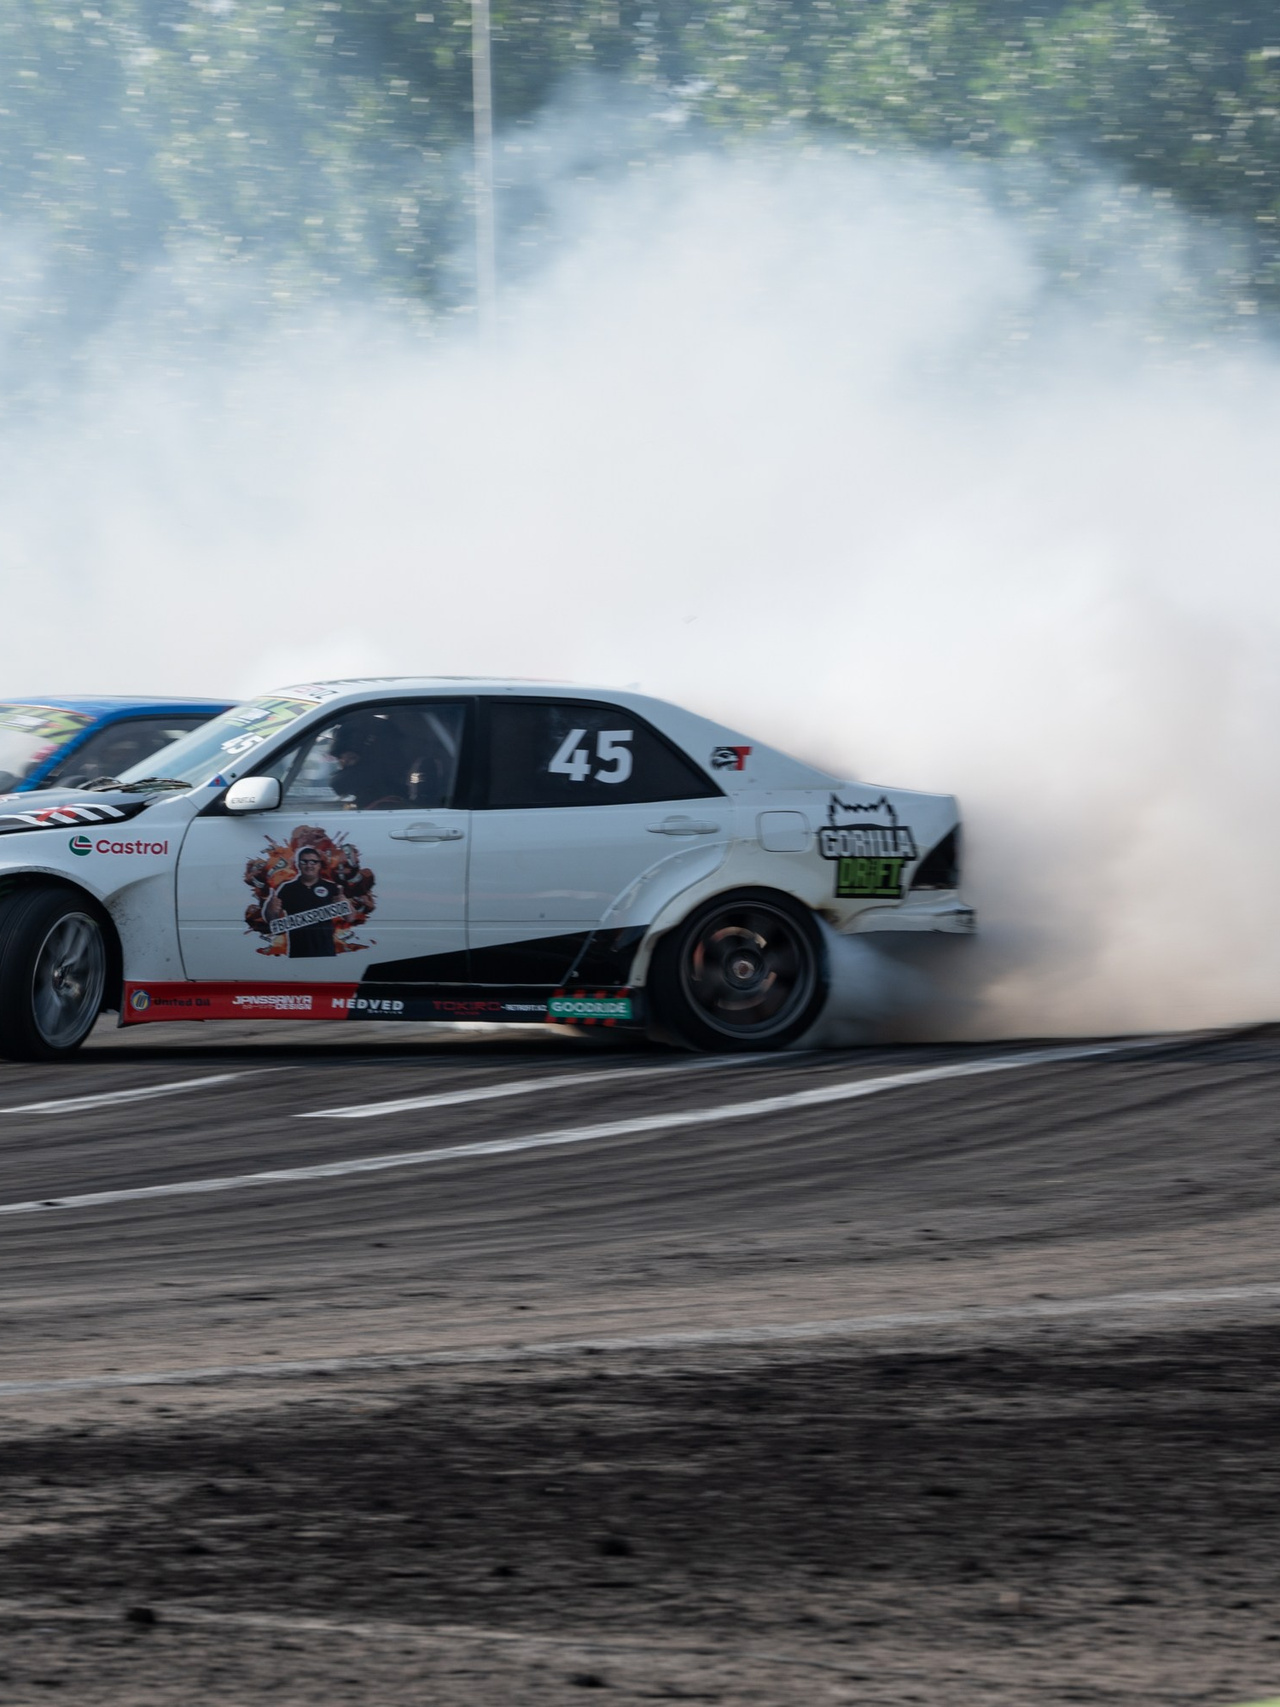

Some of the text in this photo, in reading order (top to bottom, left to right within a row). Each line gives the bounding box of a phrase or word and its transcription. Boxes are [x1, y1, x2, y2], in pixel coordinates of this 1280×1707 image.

[548, 728, 634, 784] 45
[96, 839, 168, 855] Castrol
[821, 828, 917, 859] GORILLA
[839, 858, 905, 888] DRIFT
[331, 998, 405, 1011] MEDVED
[432, 1000, 501, 1011] TOKIRO
[550, 1001, 627, 1014] GOODRIDE
